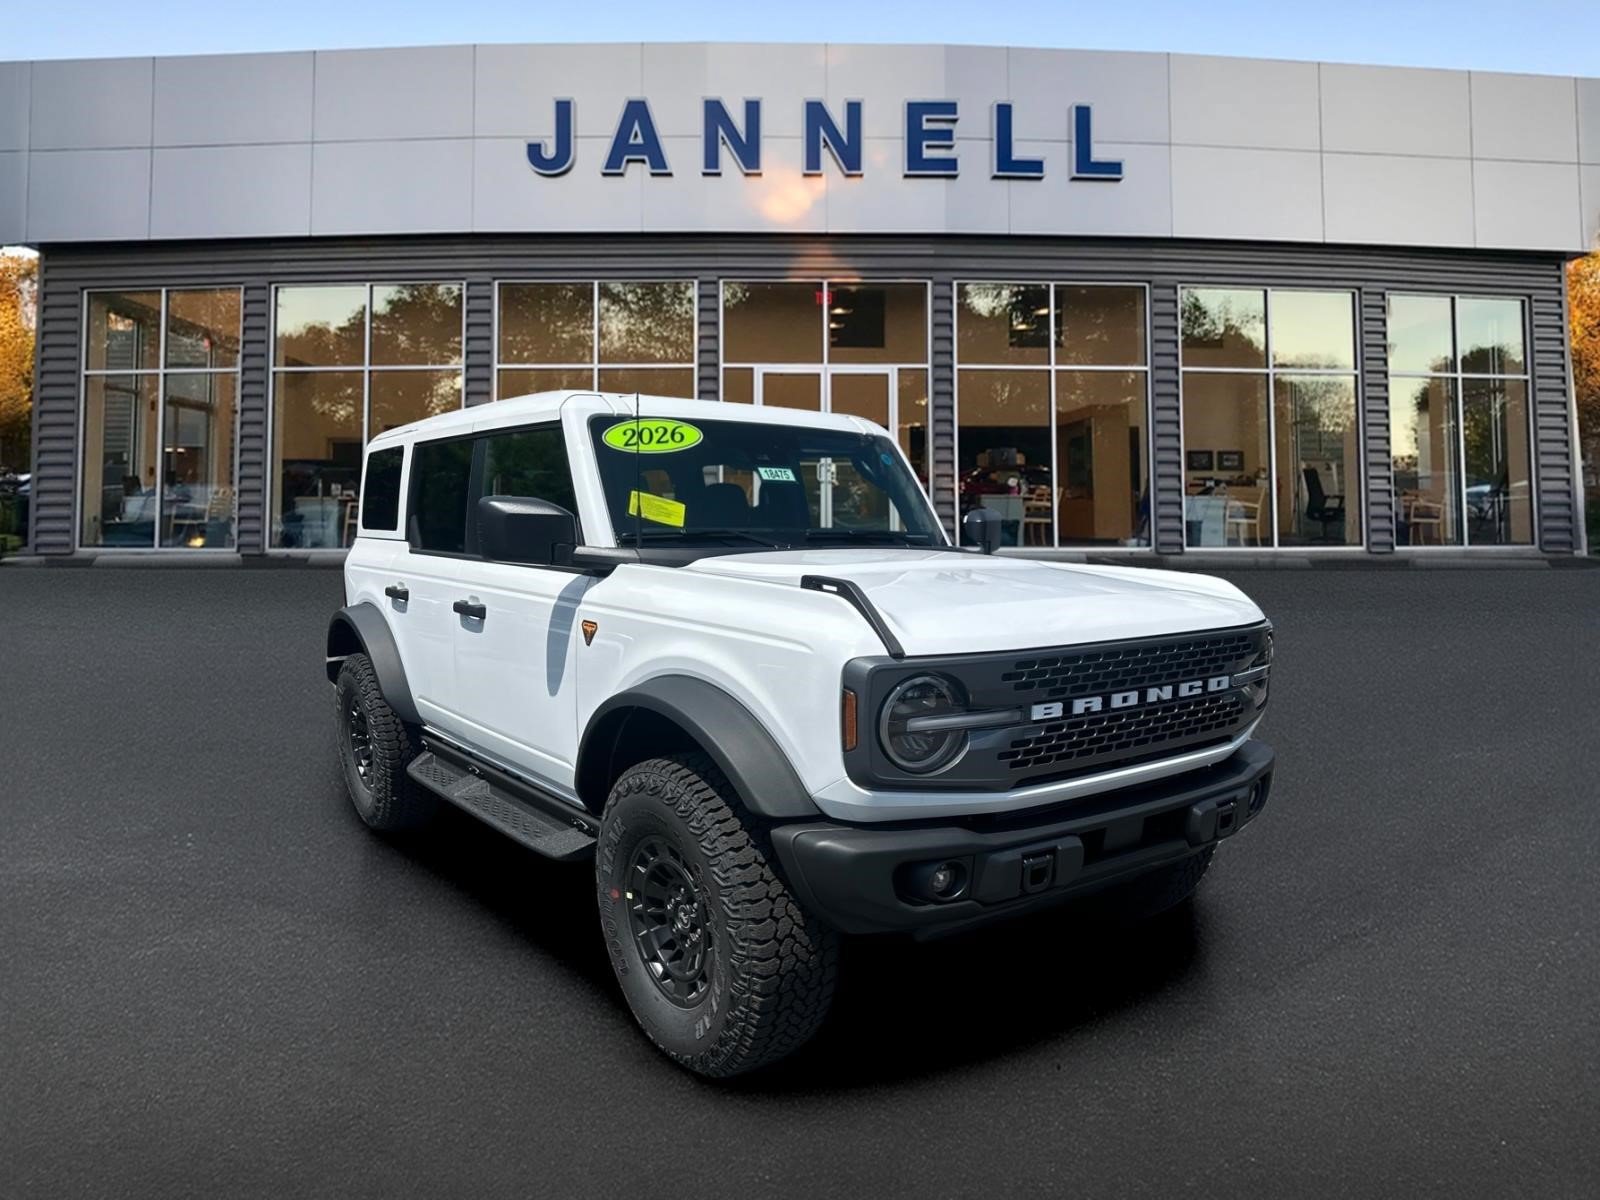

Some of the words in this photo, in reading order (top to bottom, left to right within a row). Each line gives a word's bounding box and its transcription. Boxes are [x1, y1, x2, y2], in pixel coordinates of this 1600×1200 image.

[527, 97, 1123, 180] JANNELL
[622, 425, 685, 447] 2026
[1030, 675, 1230, 721] BRONCO
